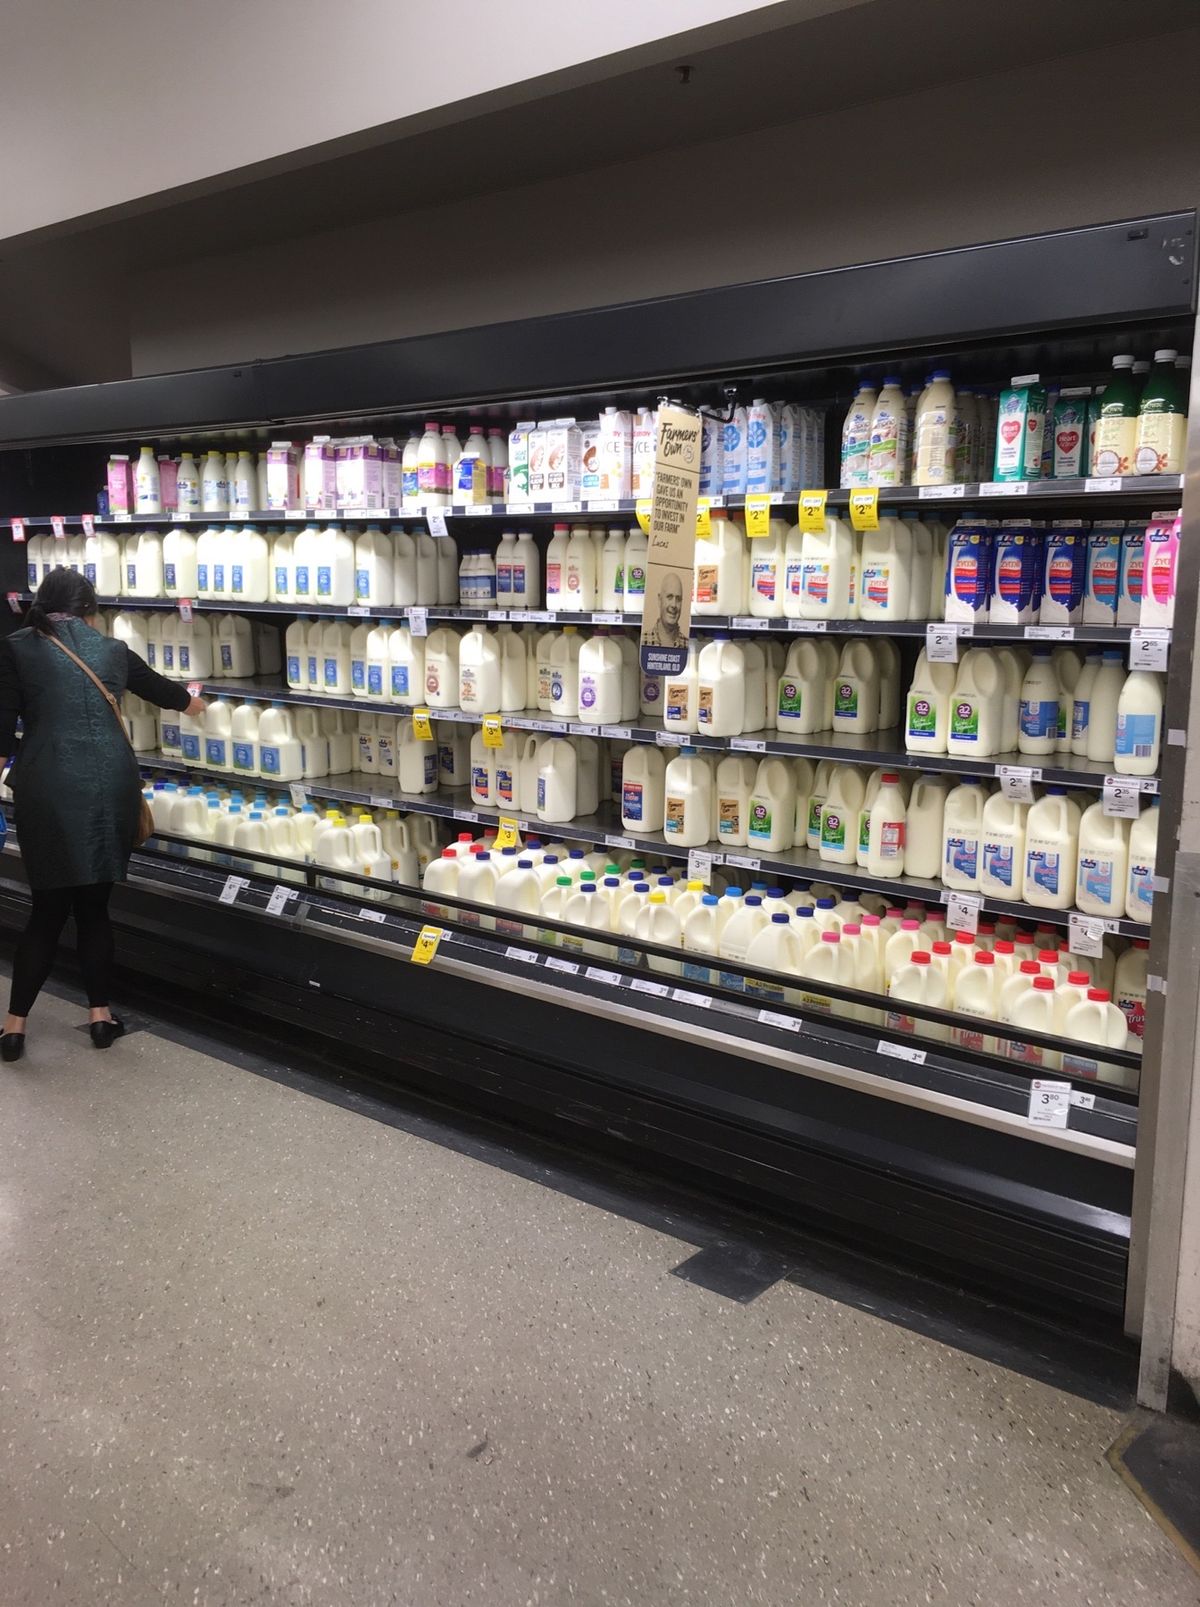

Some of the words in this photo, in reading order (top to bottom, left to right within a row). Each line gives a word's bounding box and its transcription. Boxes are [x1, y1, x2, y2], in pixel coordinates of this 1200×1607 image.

[660, 423, 699, 445] Farmers'
[664, 441, 682, 457] Own
[680, 478, 692, 488] OWN
[656, 484, 669, 495] GAVE
[669, 486, 676, 497] US
[676, 489, 684, 499] AN
[655, 496, 688, 512] OPPORTUNITY
[654, 508, 662, 519] TO
[661, 510, 679, 521] INVEST
[679, 513, 685, 523] IN
[653, 520, 664, 531] OUR
[648, 653, 668, 661] SUNSHINE
[672, 663, 680, 671] QLD
[916, 703, 928, 711] a2
[958, 705, 970, 714] a2
[755, 807, 765, 815] a2
[827, 817, 838, 825] a2
